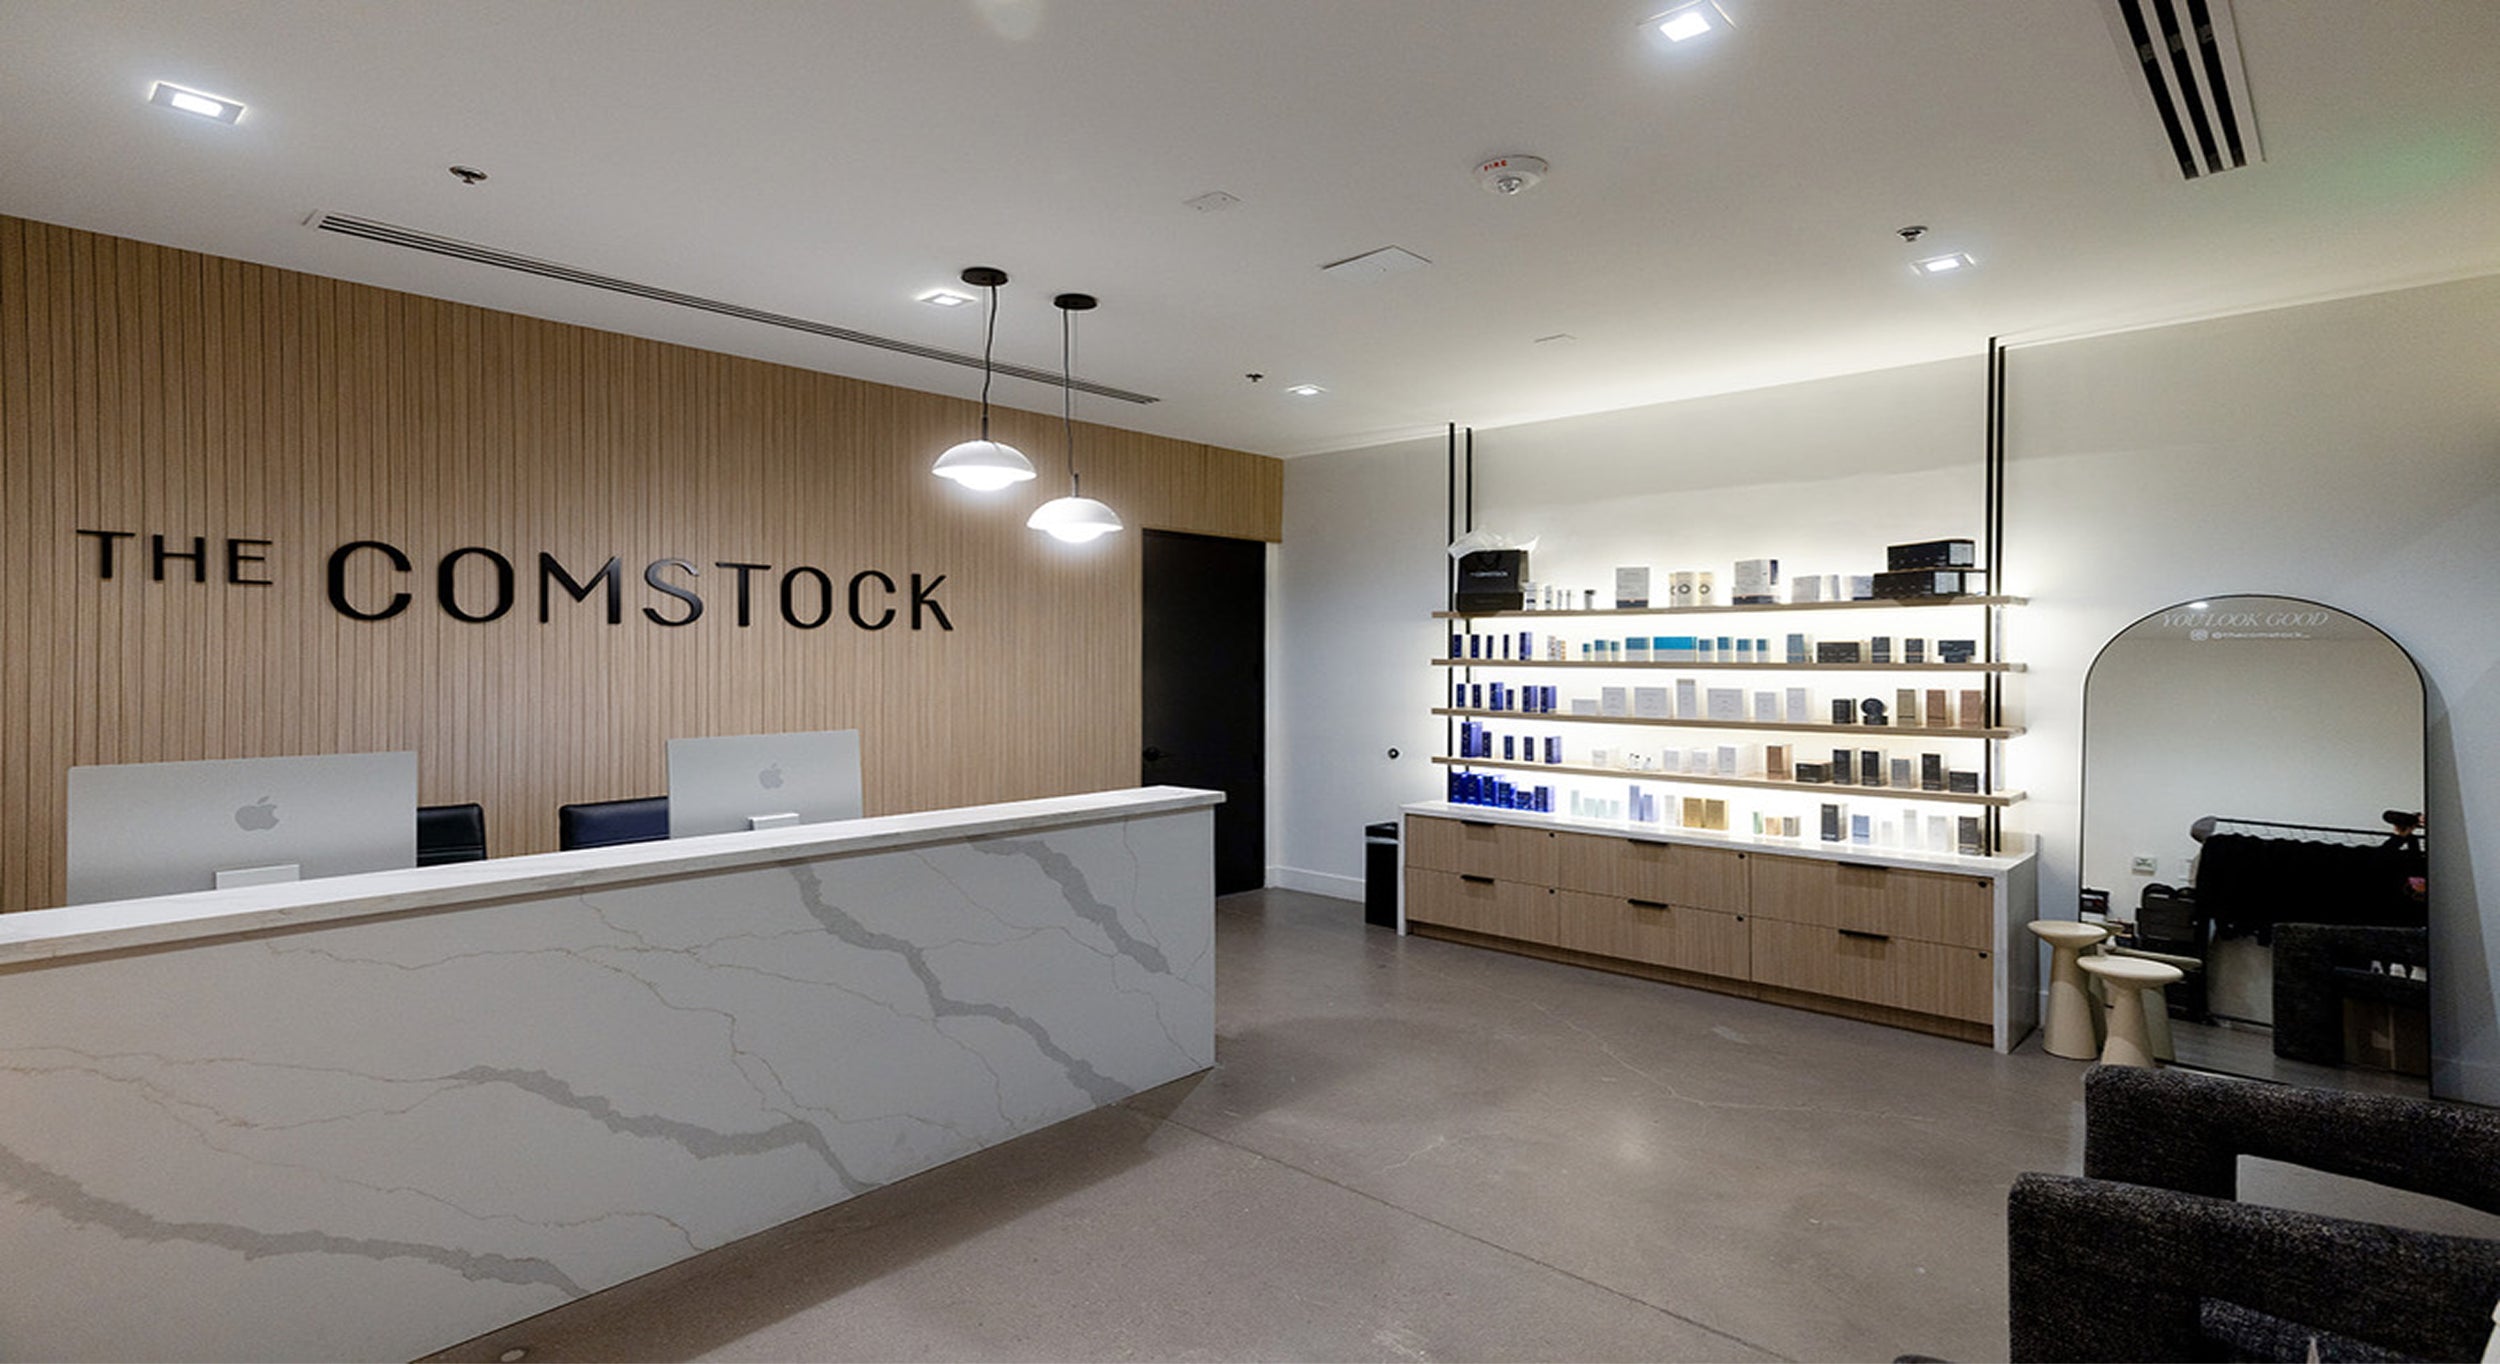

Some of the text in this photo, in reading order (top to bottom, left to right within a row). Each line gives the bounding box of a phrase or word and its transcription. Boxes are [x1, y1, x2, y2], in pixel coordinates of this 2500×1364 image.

[1484, 160, 1507, 171] FIRE
[76, 529, 954, 631] THE COMSTOCK
[2162, 611, 2329, 627] YOU LOOK GOOD
